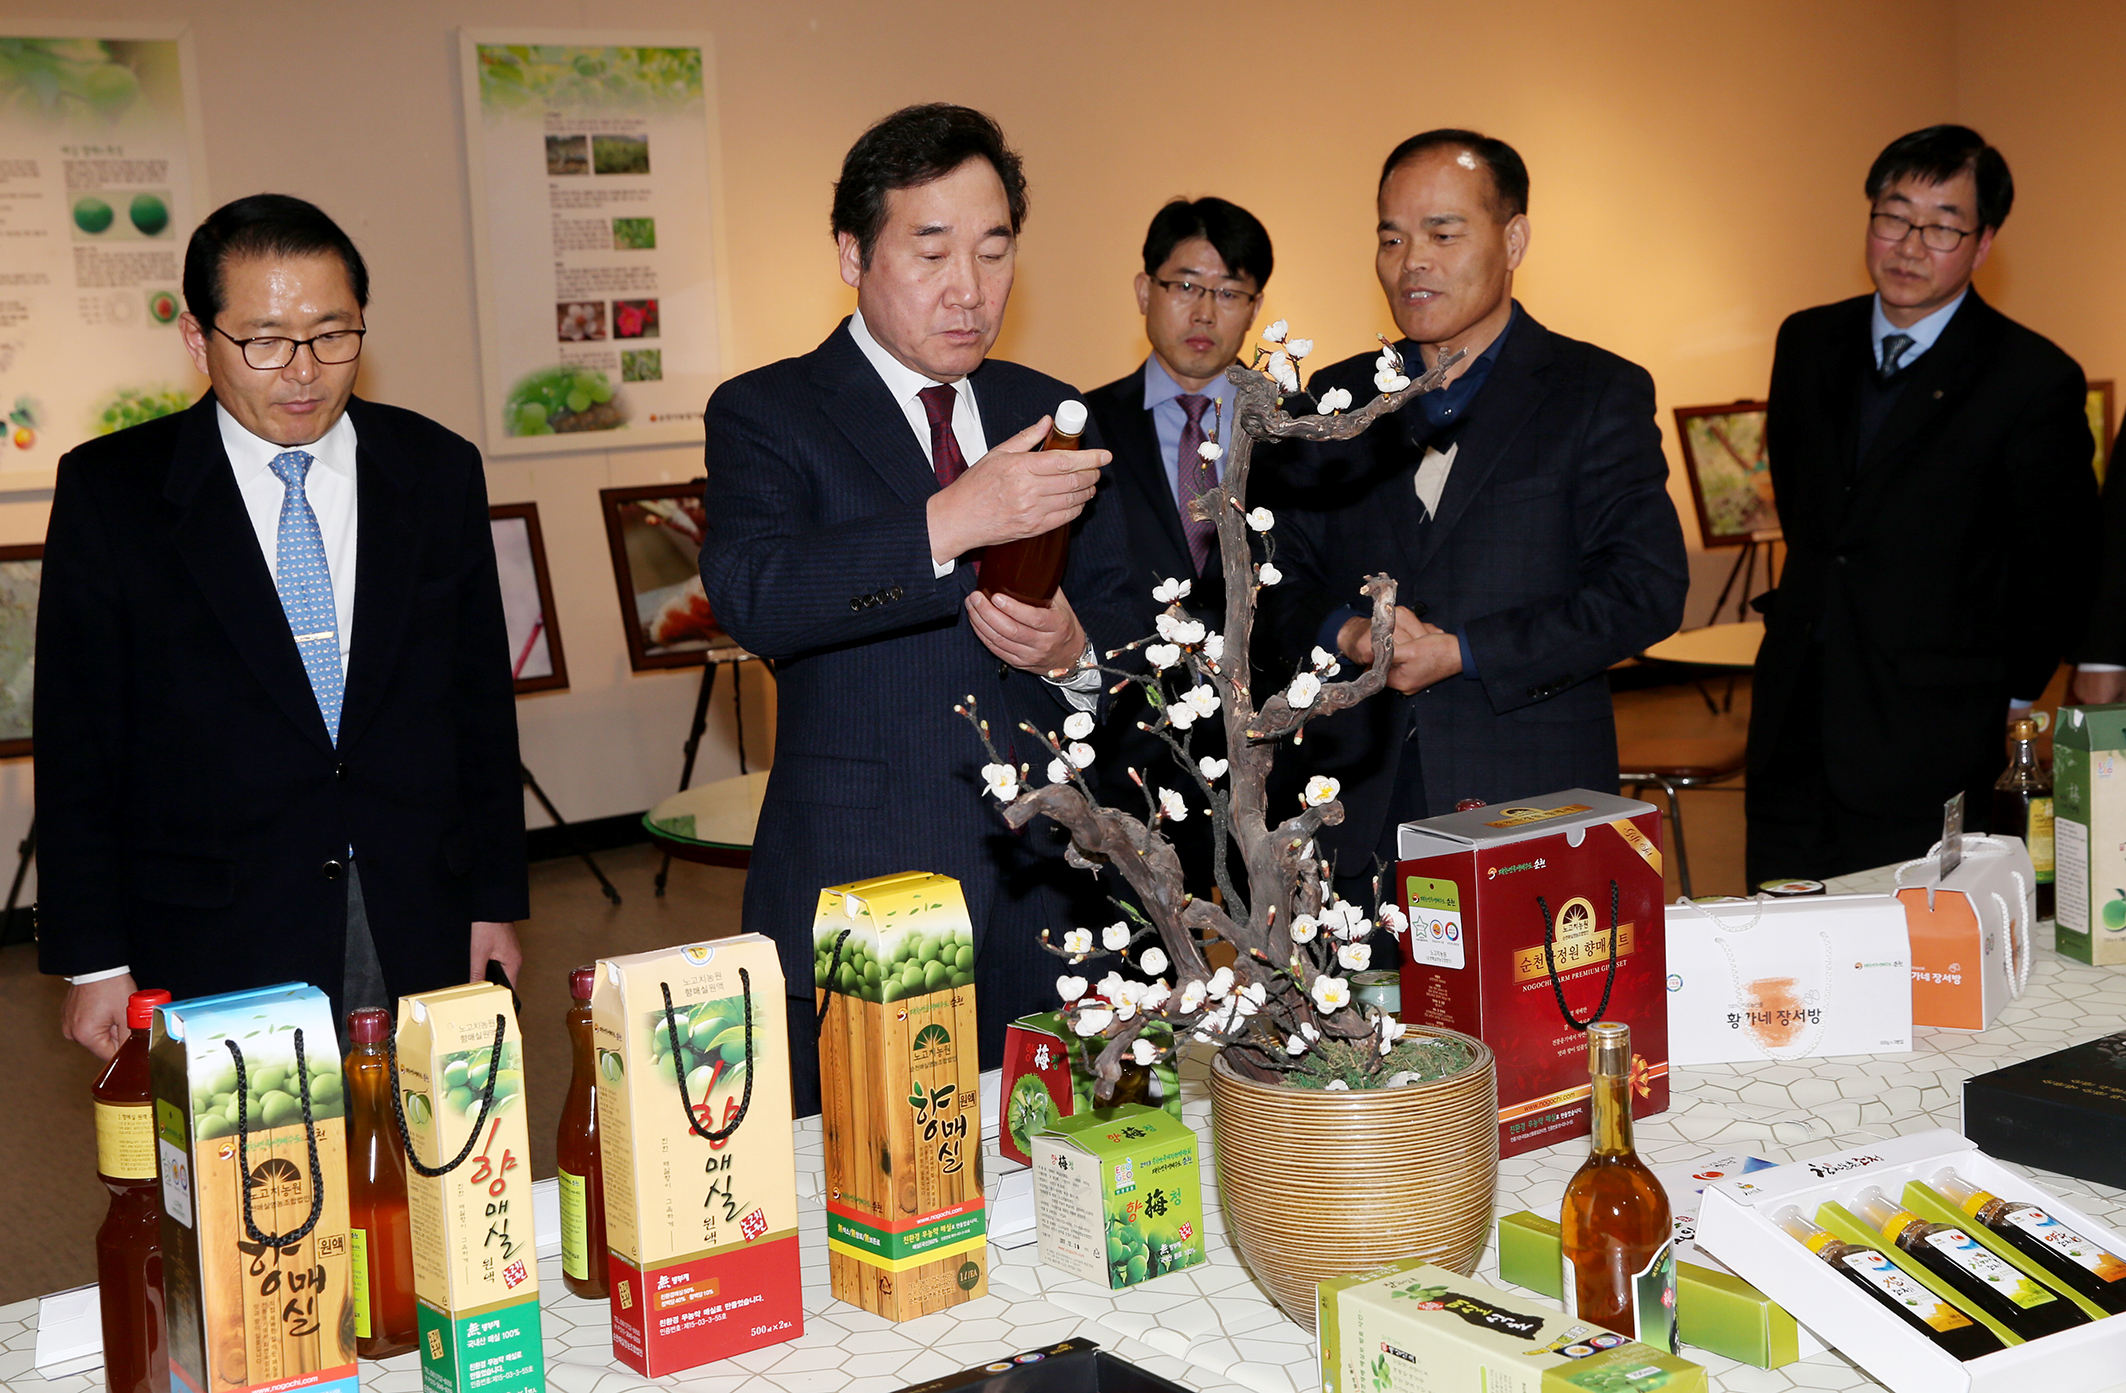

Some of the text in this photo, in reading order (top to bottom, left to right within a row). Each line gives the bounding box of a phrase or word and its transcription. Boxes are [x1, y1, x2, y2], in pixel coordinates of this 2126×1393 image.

[1520, 932, 1629, 974] 순천정원 향매트
[1571, 966, 1600, 980] PREMIUM
[1616, 959, 1628, 968] SET
[1911, 971, 1962, 986] 가네 장서방
[1776, 1008, 1822, 1027] 장서방
[960, 1093, 976, 1108] 원액
[1523, 1091, 1576, 1112] www.nogochi.com
[916, 1206, 963, 1225] www.nogochi.com
[703, 1215, 717, 1246] 원액
[319, 1237, 345, 1256] 원액
[482, 1257, 496, 1284] 원액
[659, 1315, 680, 1328] 친환경
[681, 1310, 702, 1322] 무농약
[703, 1304, 723, 1317] 매실로
[467, 1327, 521, 1348] 국내산 매실 100%
